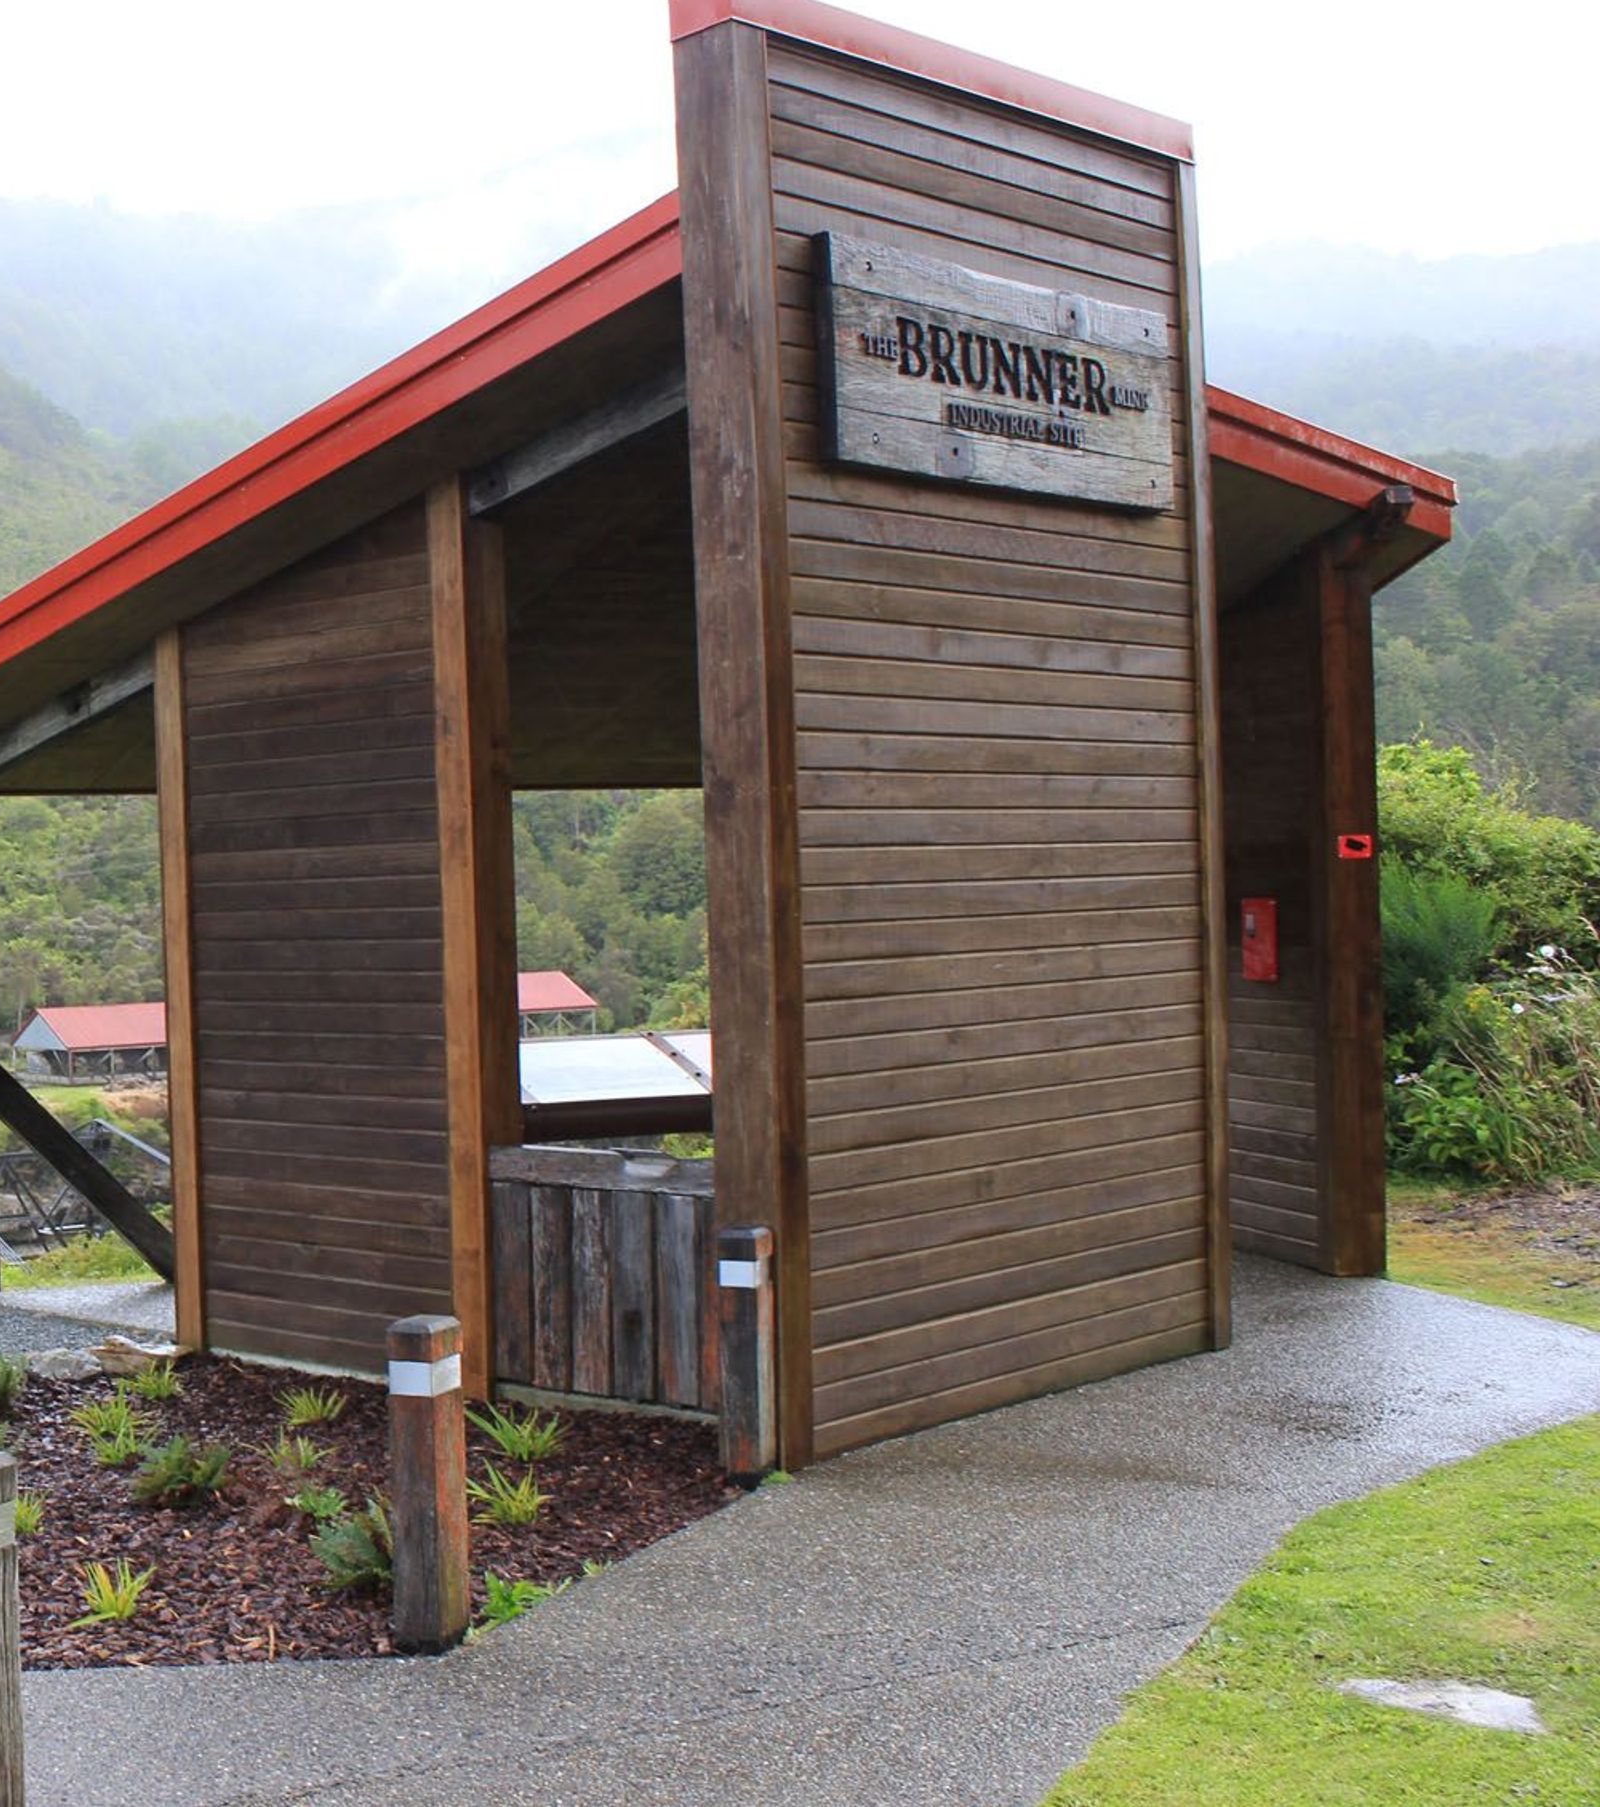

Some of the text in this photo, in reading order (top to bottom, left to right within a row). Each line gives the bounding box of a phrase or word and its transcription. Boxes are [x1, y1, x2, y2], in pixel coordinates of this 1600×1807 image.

[861, 332, 898, 360] THE
[896, 316, 1111, 416] BRUNNER
[947, 402, 1086, 449] INDUSTRIAL SITE
